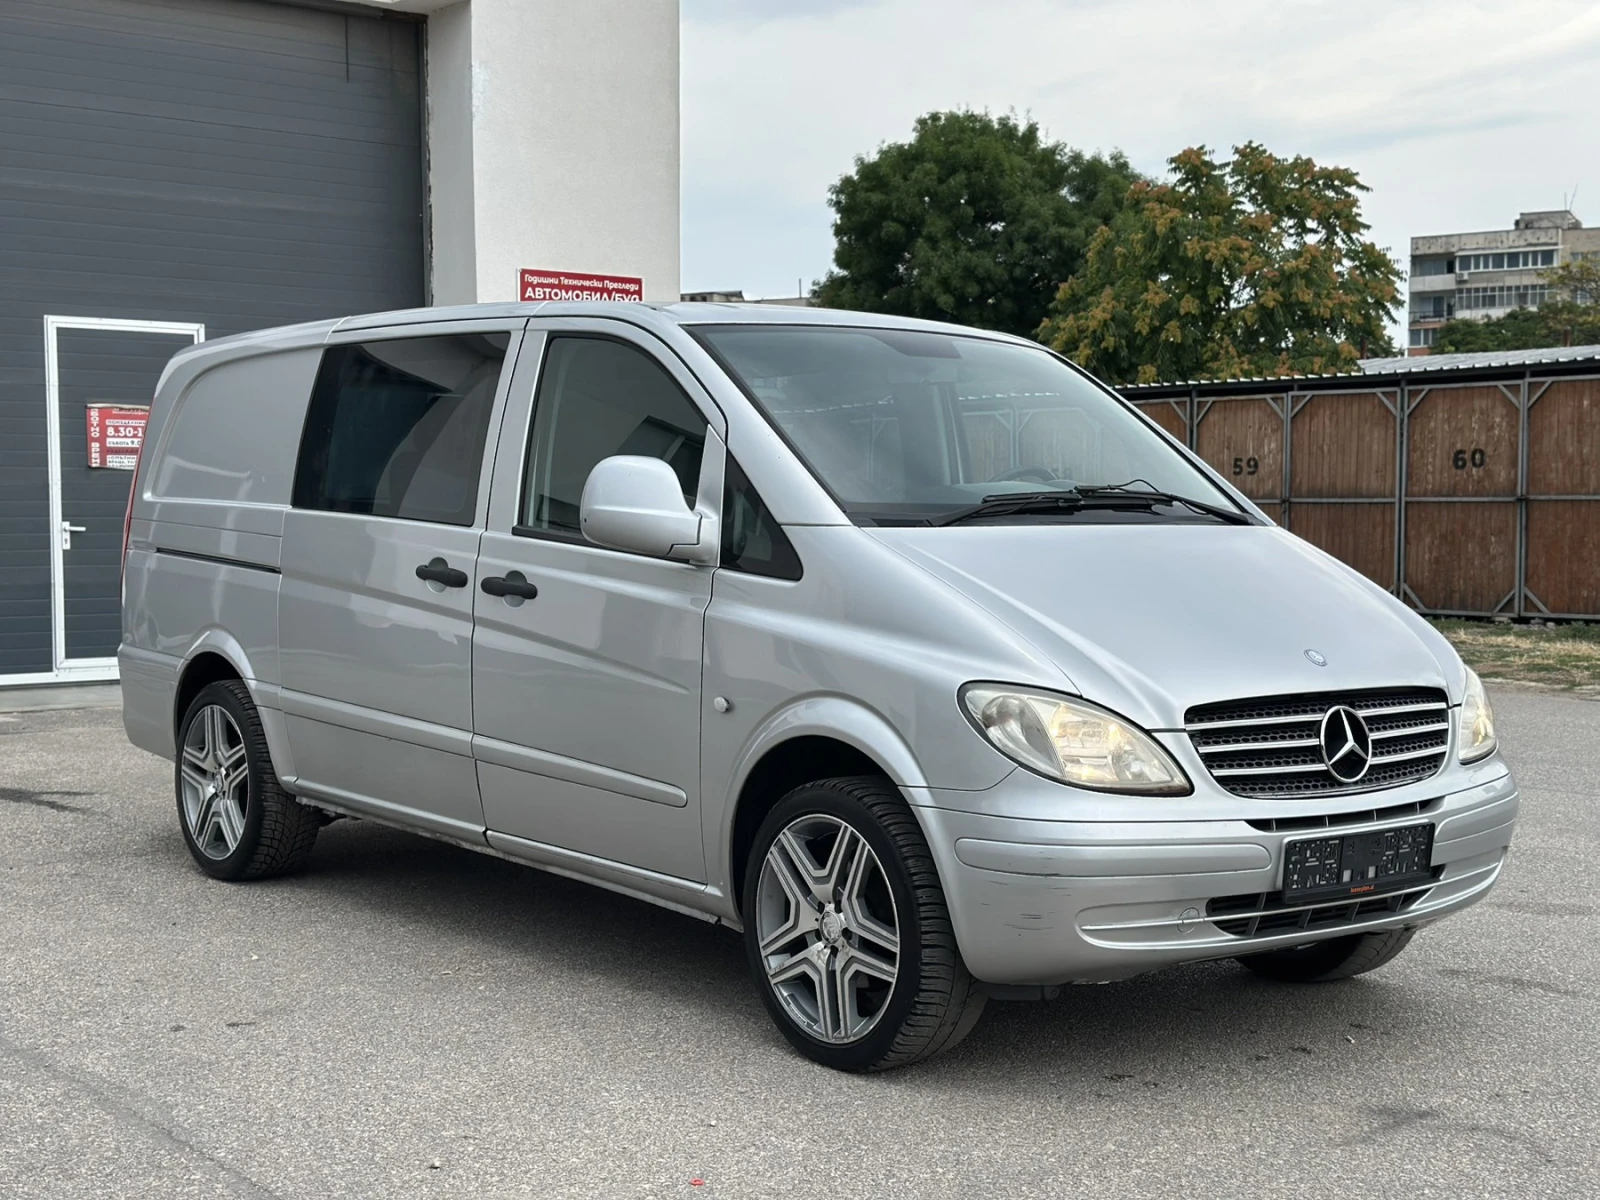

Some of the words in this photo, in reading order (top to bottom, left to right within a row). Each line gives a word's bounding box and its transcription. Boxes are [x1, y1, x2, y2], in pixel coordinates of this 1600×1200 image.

[524, 273, 559, 285] Годишни
[560, 276, 603, 288] Технически
[603, 279, 639, 292] Прегледи
[1232, 456, 1259, 476] 59
[1452, 448, 1486, 470] 60
